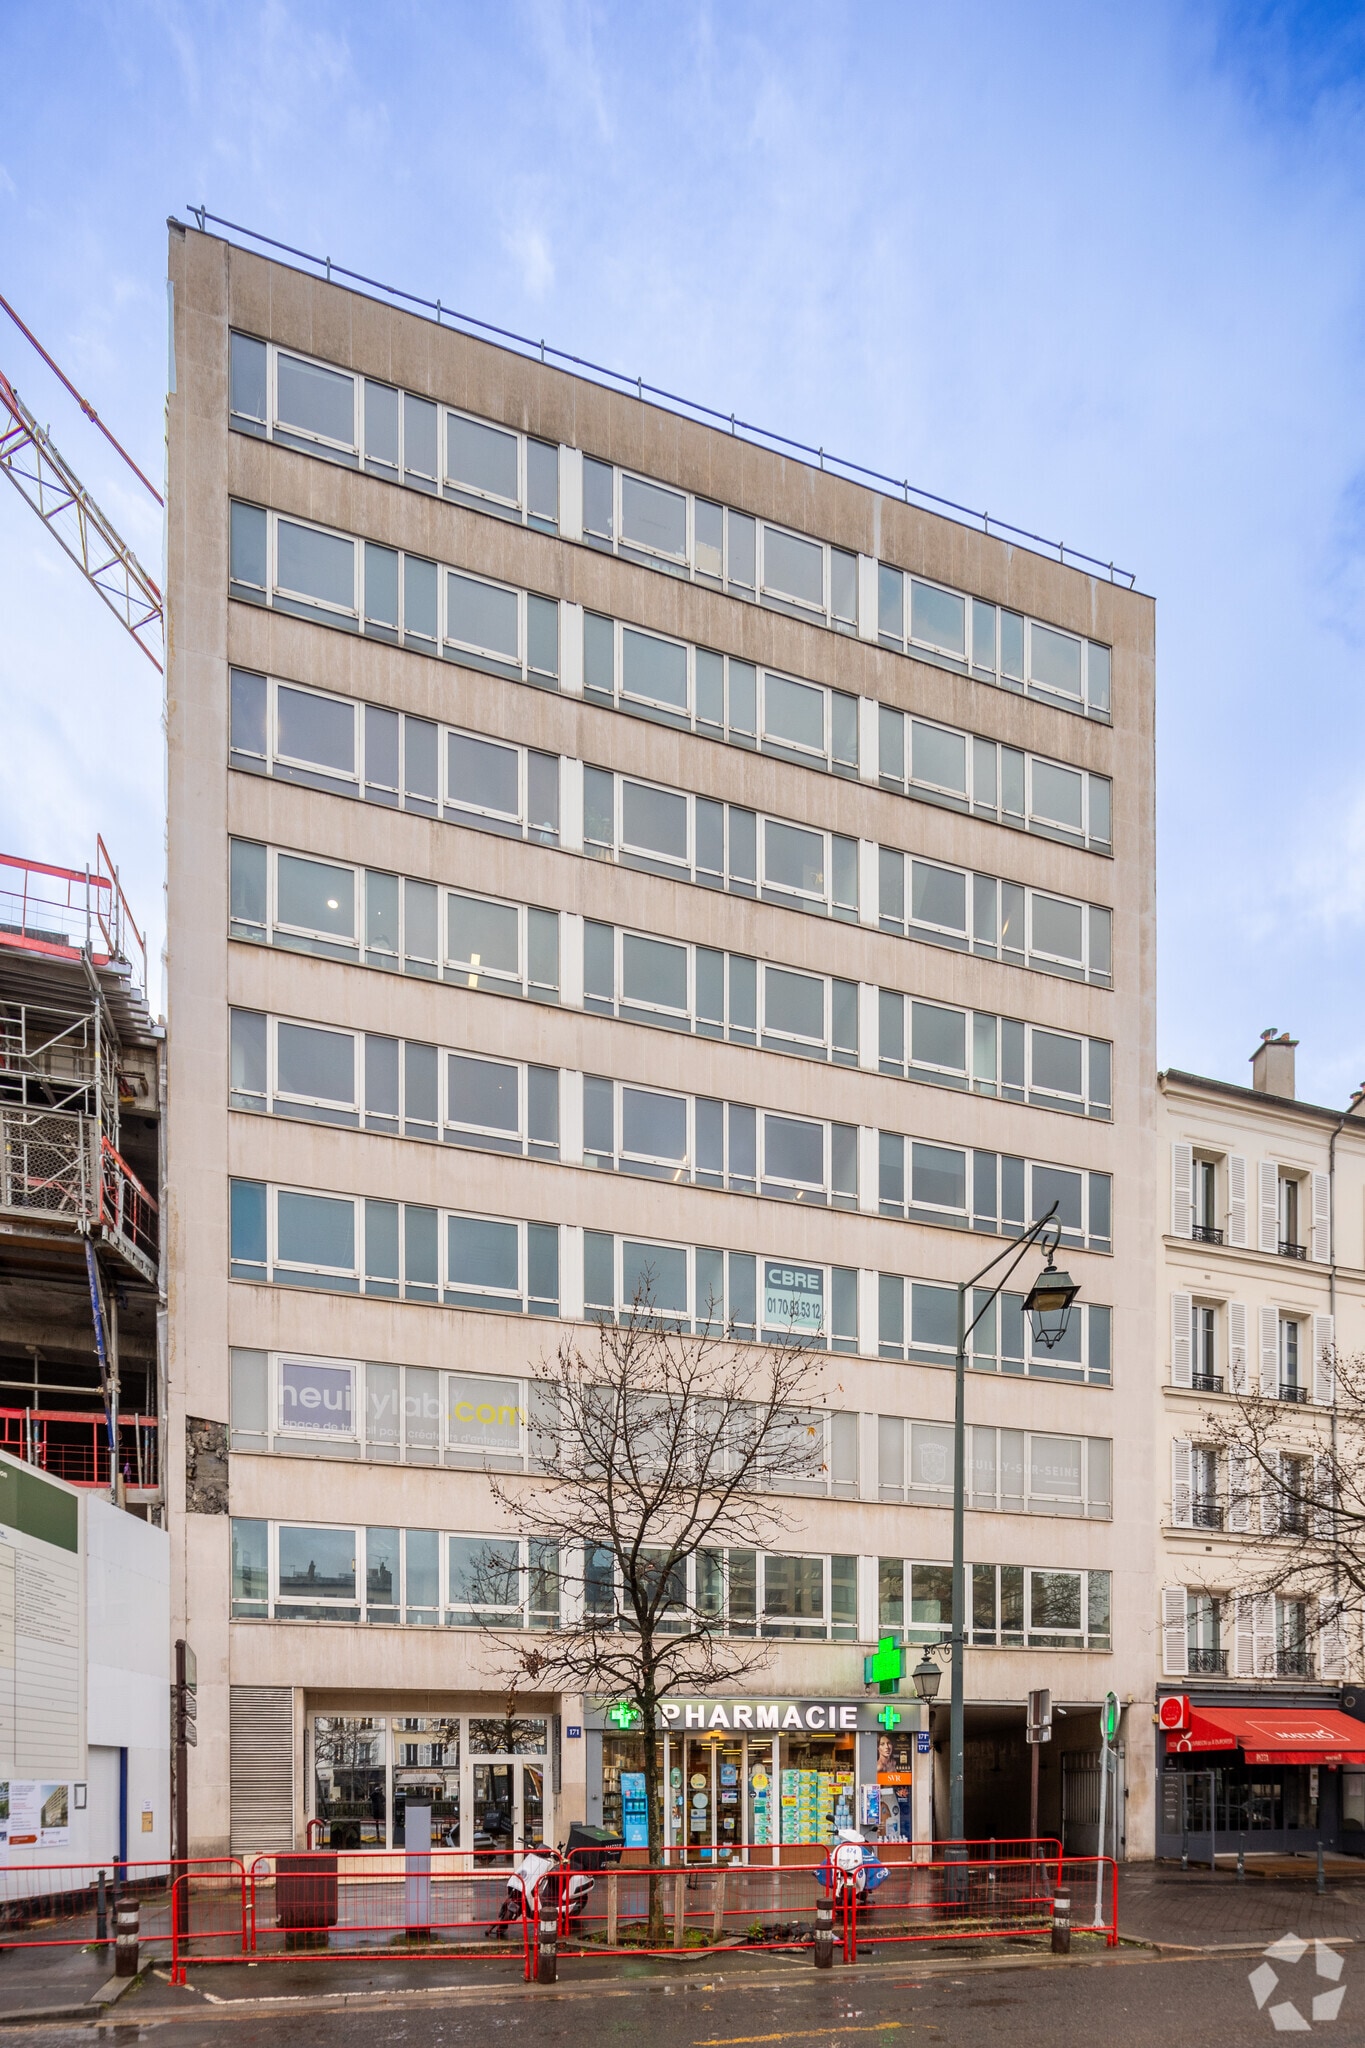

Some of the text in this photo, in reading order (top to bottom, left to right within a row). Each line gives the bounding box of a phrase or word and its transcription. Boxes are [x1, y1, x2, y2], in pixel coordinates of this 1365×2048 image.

[768, 1268, 819, 1290] CBRE
[767, 1297, 777, 1313] 01
[778, 1298, 788, 1315] 70
[801, 1301, 811, 1318] 53
[812, 1303, 820, 1319] 12
[279, 1384, 526, 1427] neuilylab.com
[323, 1421, 338, 1431] de
[341, 1423, 376, 1436] traail
[380, 1427, 404, 1438] pou
[965, 1458, 1080, 1479] EUILLY-SUR-SEINE
[661, 1703, 858, 1729] PHARMACIE
[569, 1728, 580, 1736] 171
[887, 1774, 902, 1782] SVR
